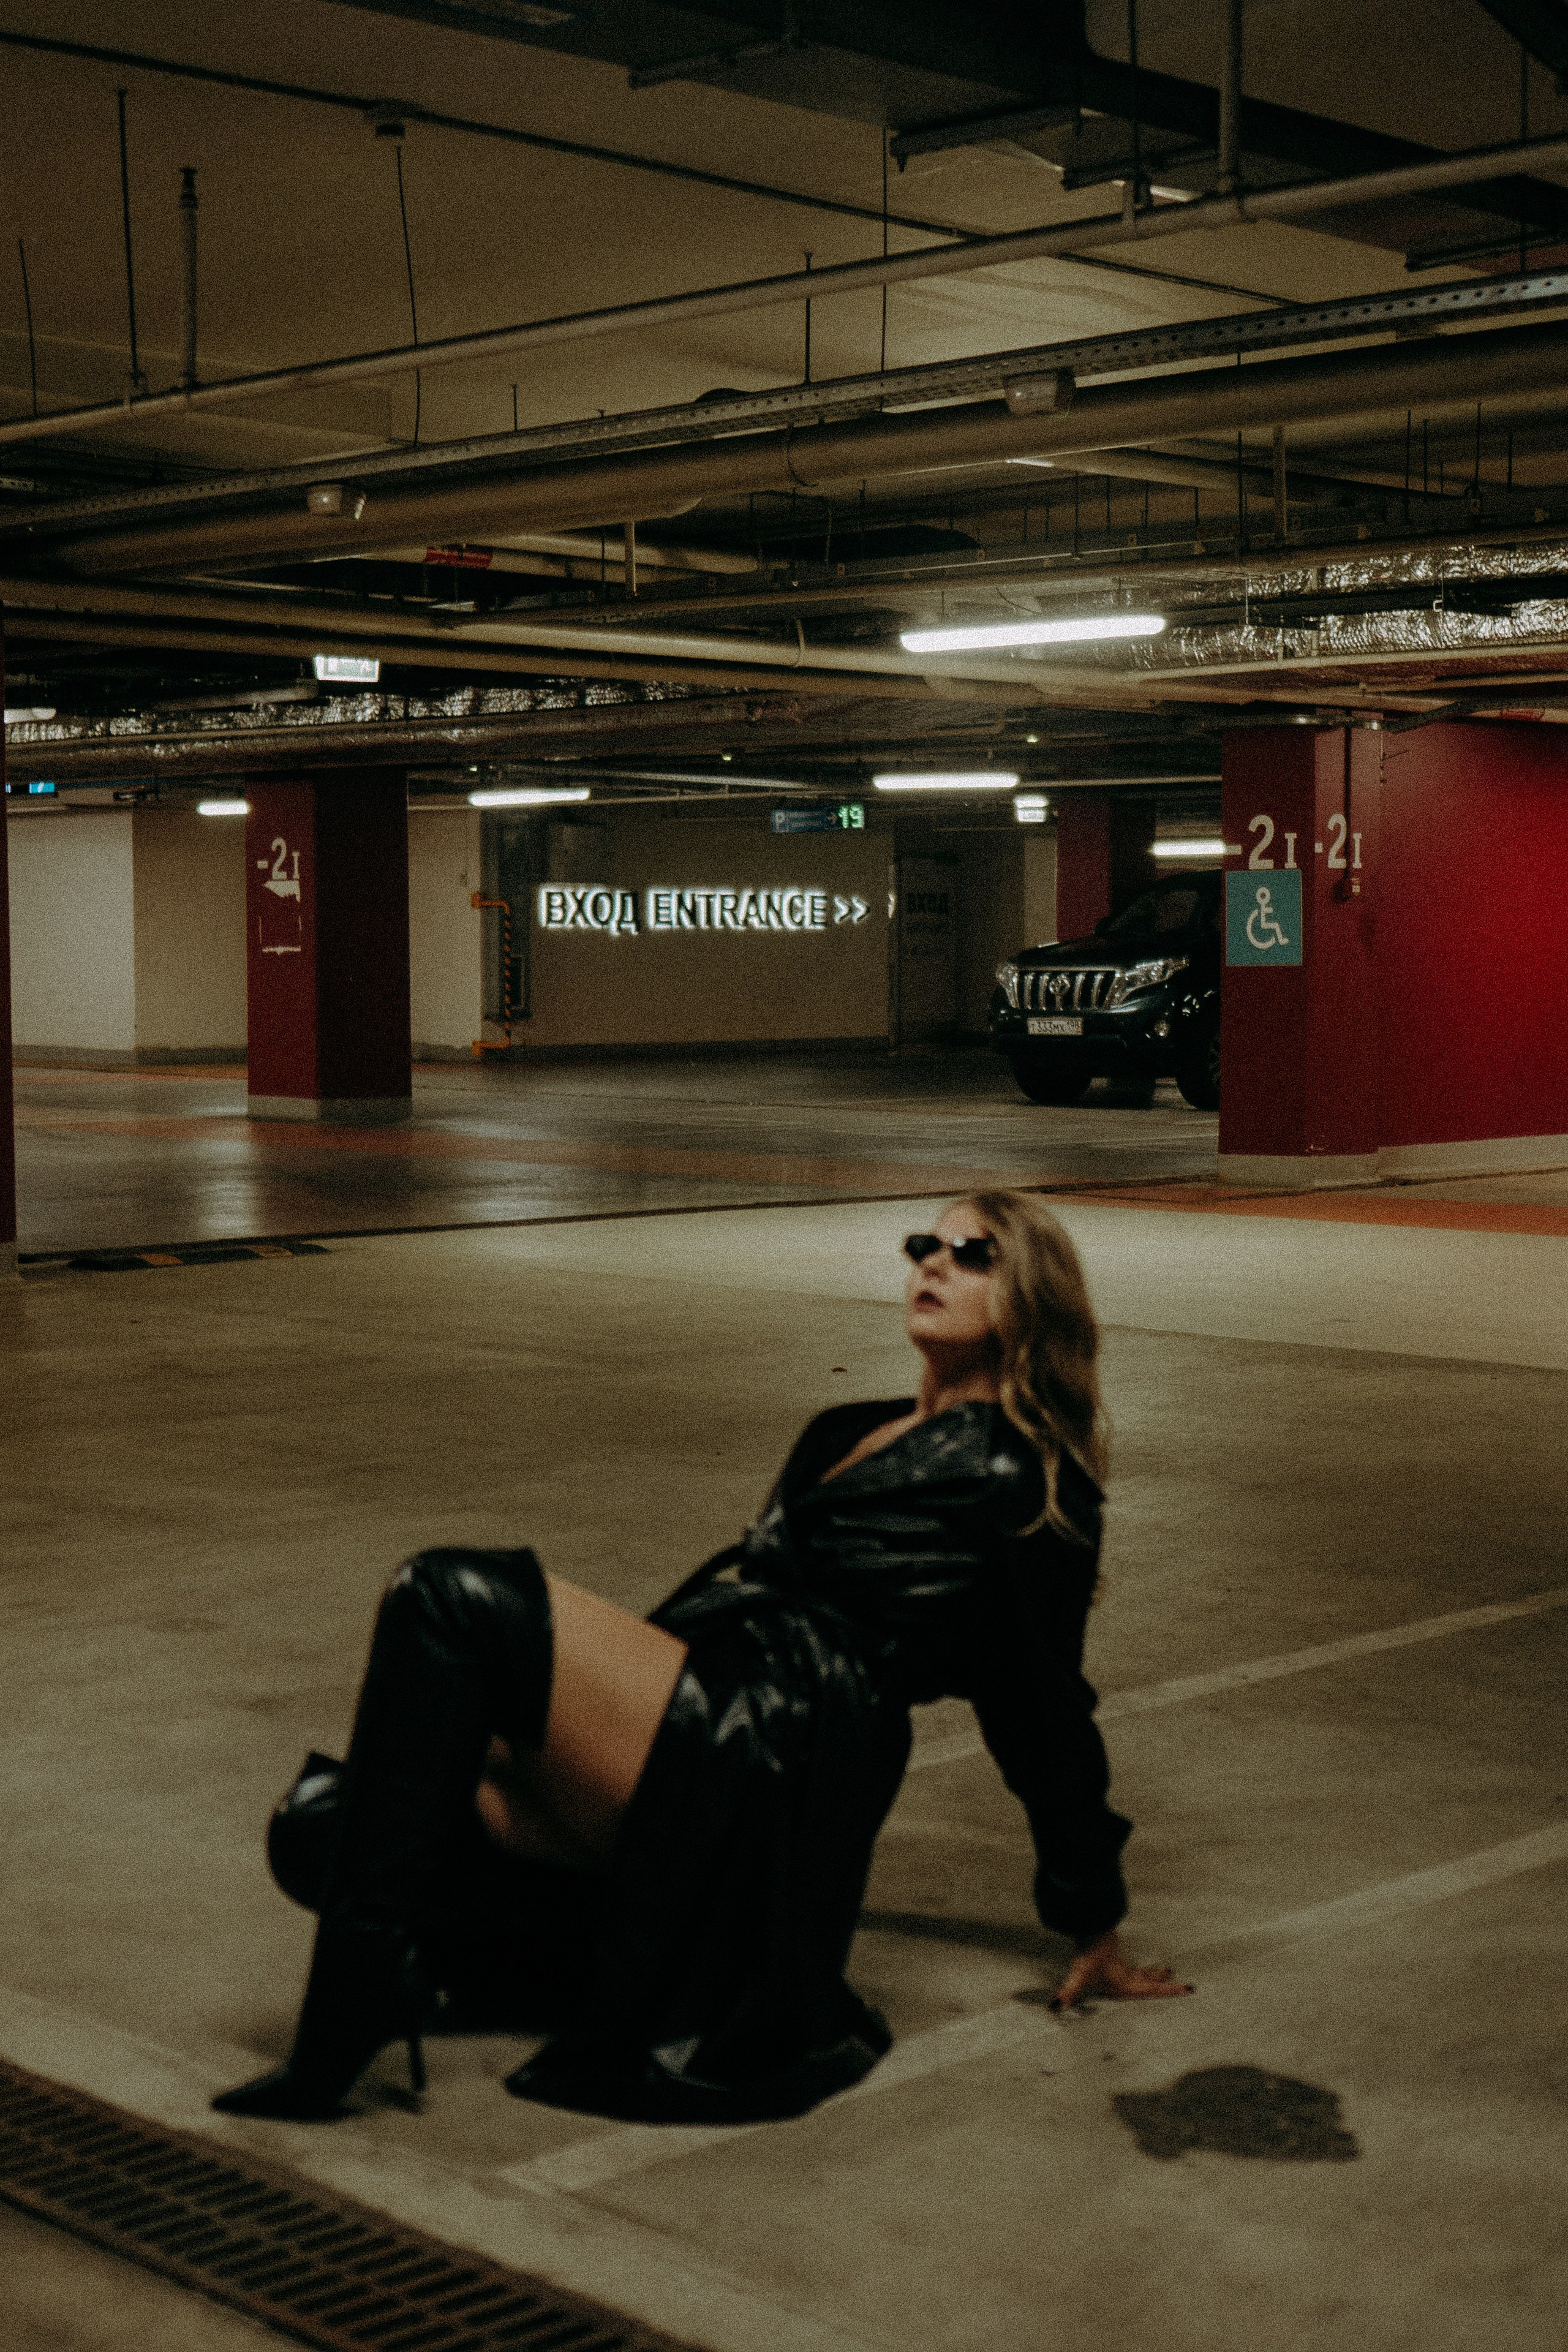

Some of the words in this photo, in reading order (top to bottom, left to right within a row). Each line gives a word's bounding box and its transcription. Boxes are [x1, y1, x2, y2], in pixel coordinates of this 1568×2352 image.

[838, 804, 864, 828] 19
[541, 888, 639, 935] ВХОД
[648, 888, 827, 930] ENTRANCE
